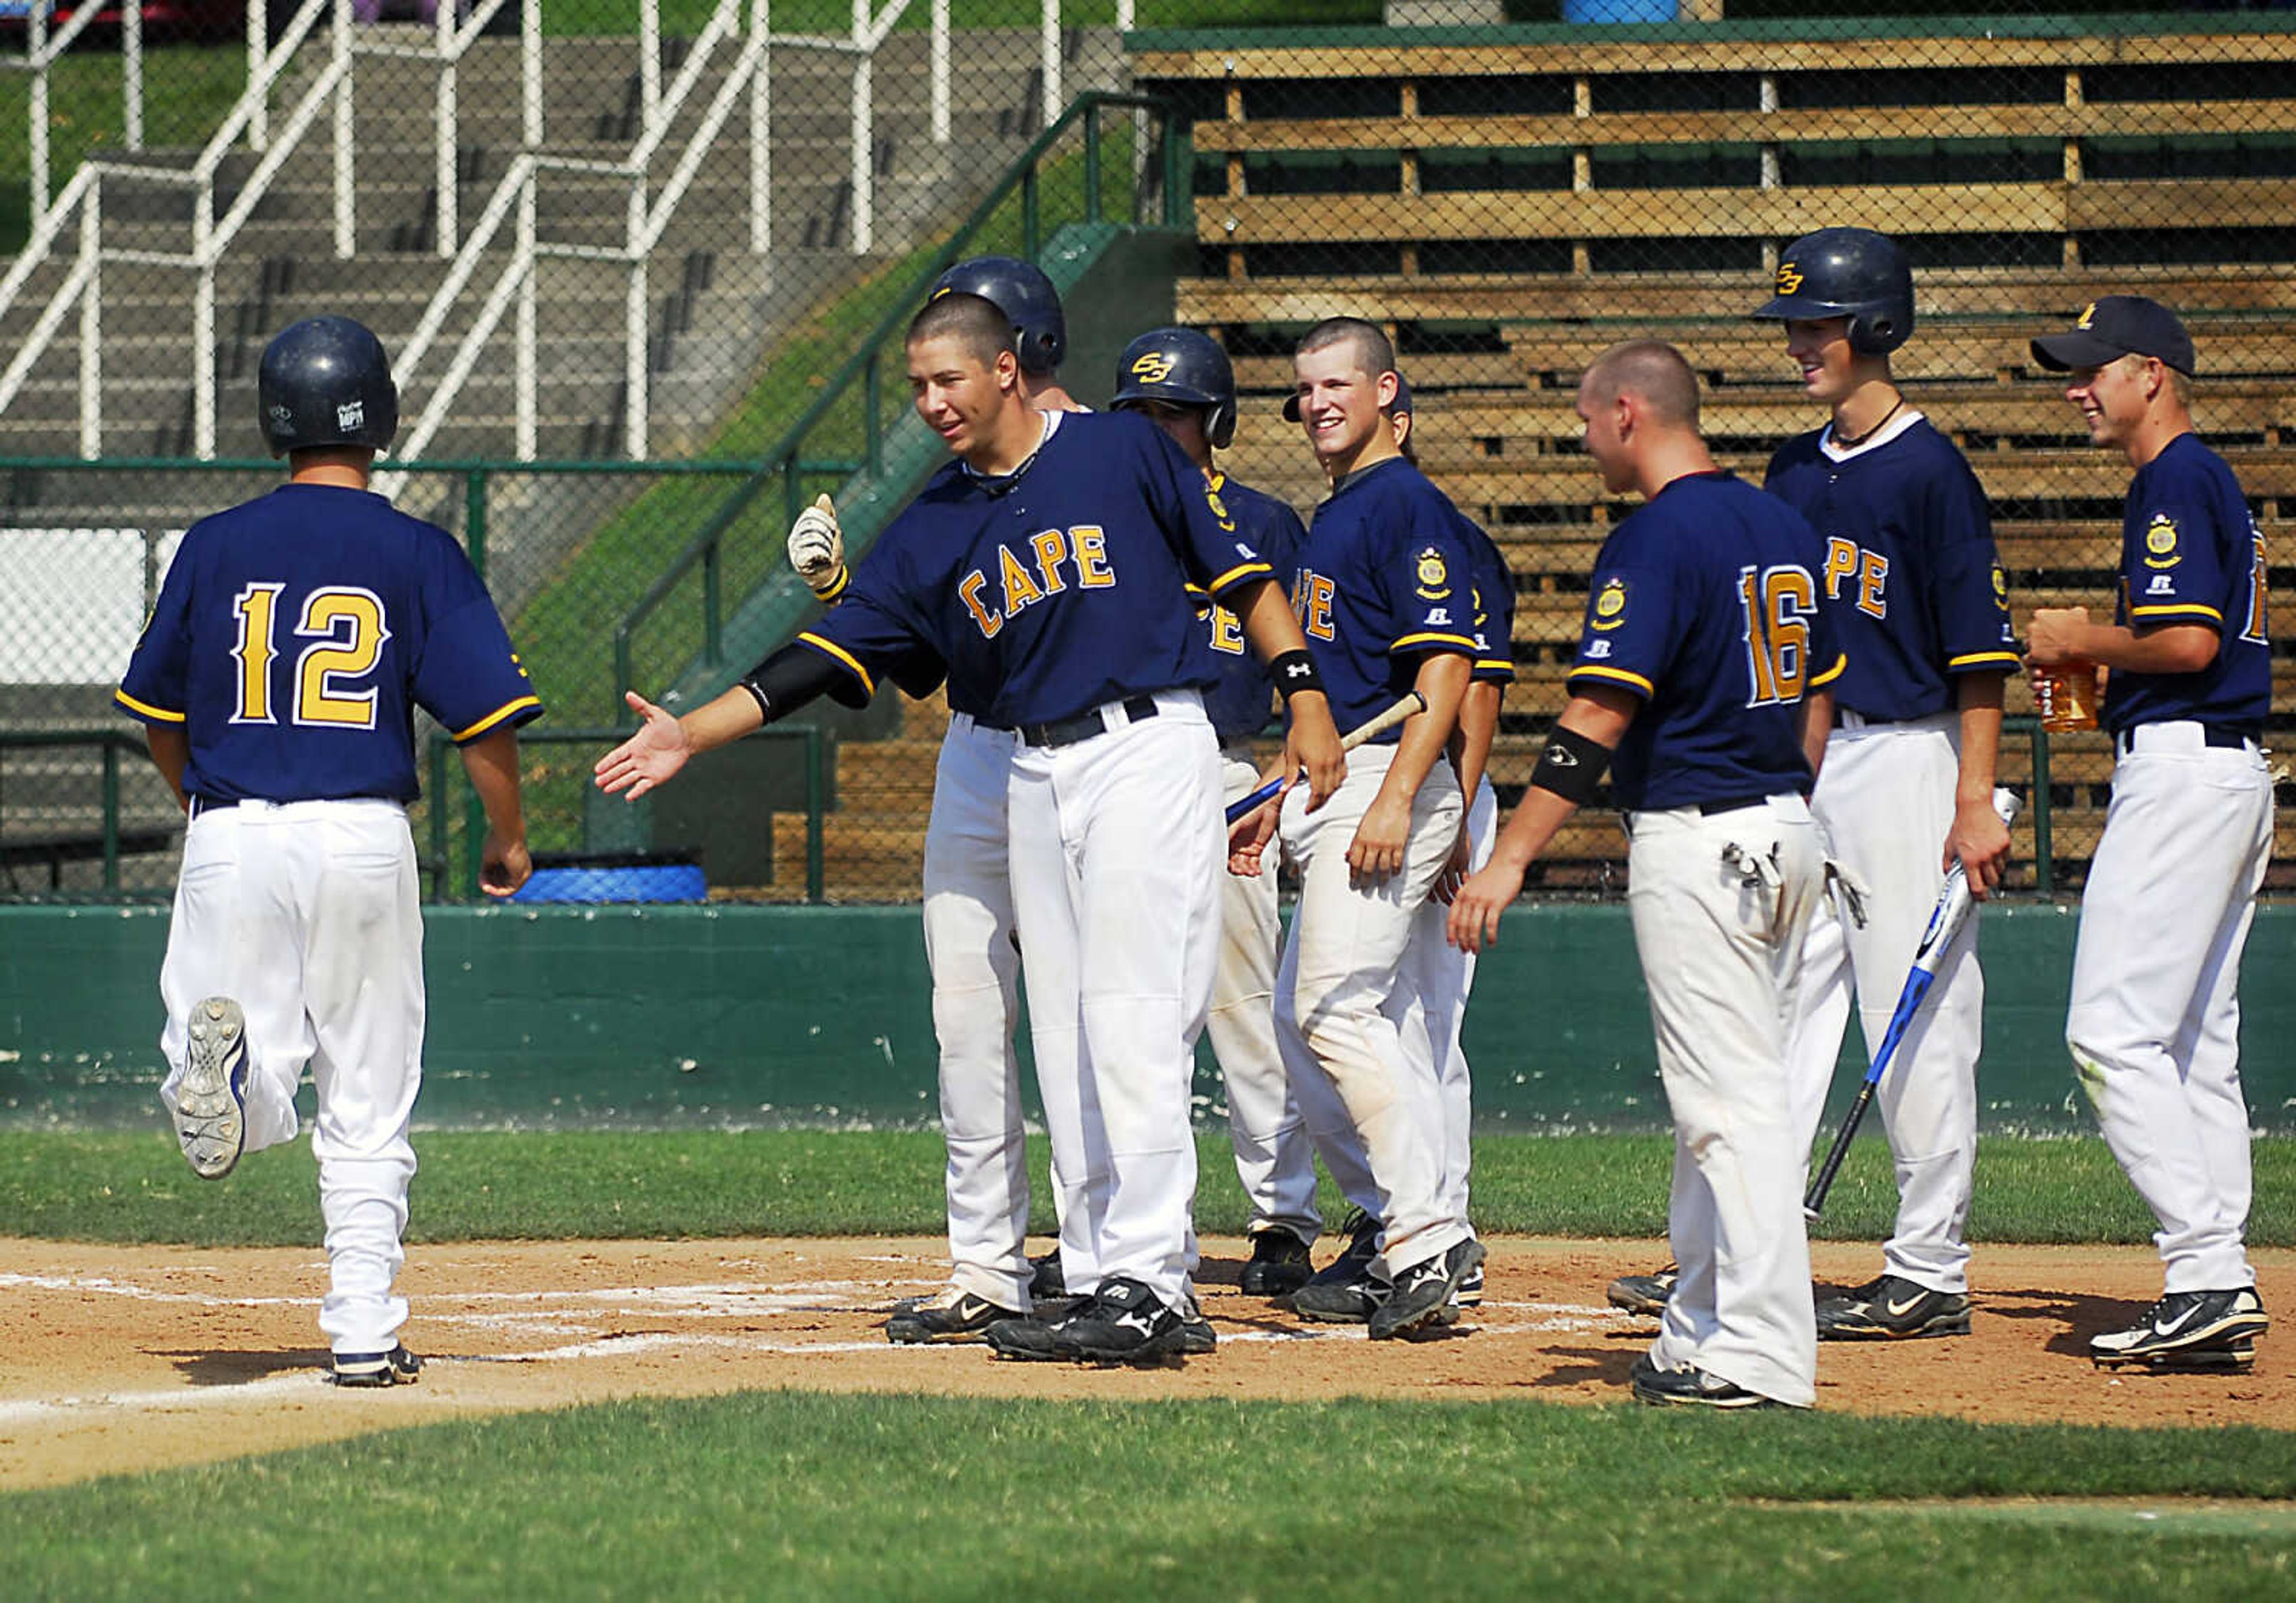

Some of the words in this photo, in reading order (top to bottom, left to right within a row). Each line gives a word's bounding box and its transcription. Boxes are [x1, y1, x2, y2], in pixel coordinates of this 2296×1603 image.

[958, 525, 1116, 639] CAPE
[1737, 564, 1818, 708] 16
[1822, 537, 1889, 619] PE
[229, 582, 393, 730] 12
